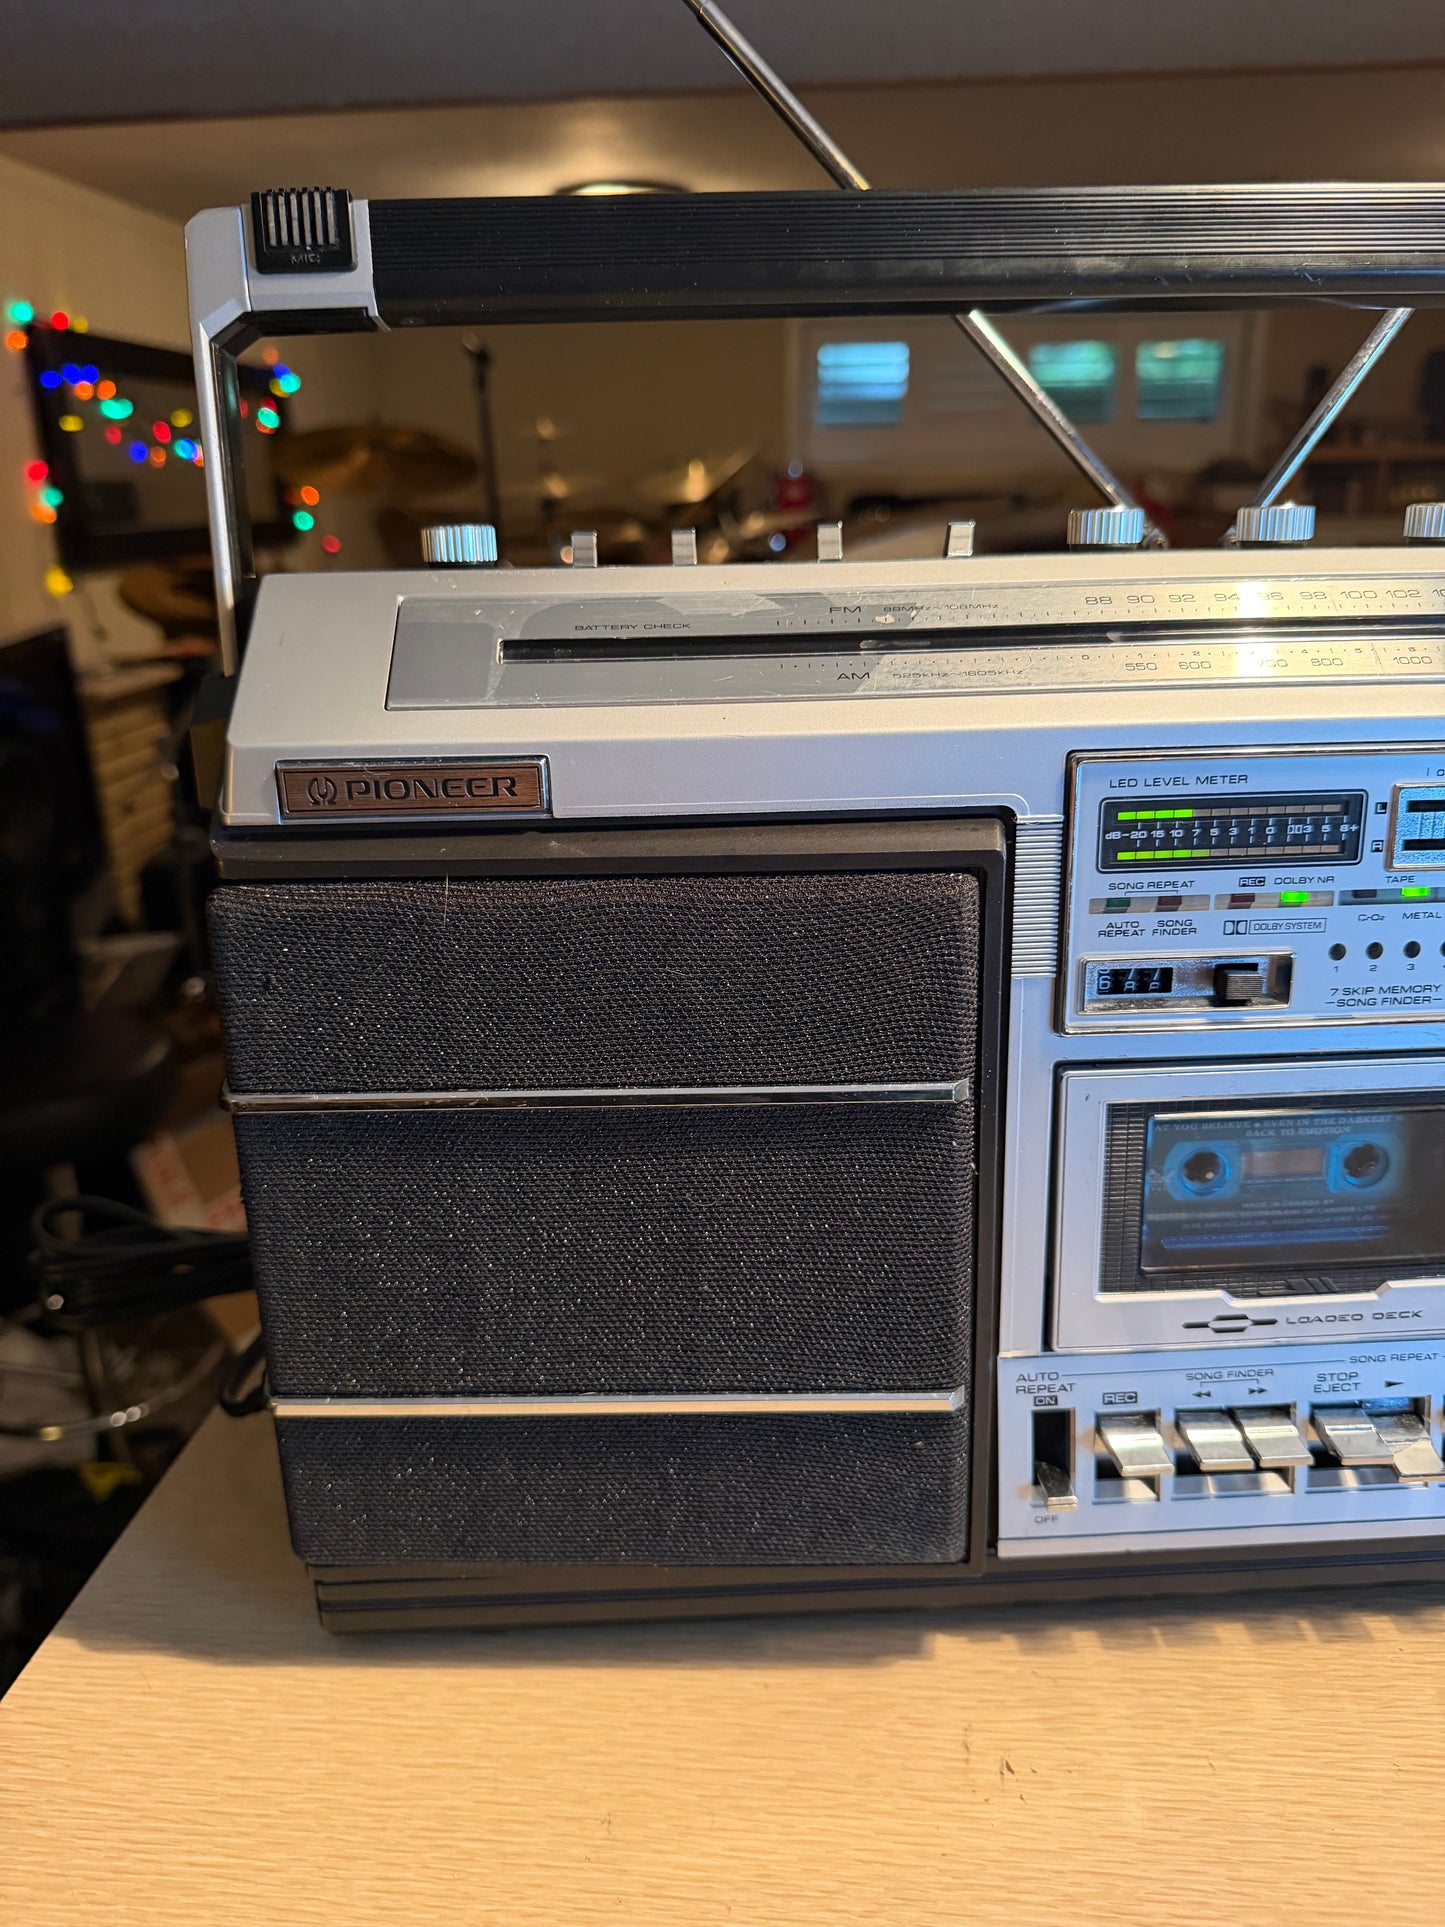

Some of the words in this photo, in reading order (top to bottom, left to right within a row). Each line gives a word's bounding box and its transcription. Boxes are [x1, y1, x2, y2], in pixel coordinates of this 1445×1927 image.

[1085, 596, 1112, 605] 88
[1127, 595, 1155, 604] 90
[1169, 594, 1197, 602] 92
[1214, 593, 1240, 601] 94
[1299, 591, 1327, 600] 98
[1340, 590, 1378, 600] 100
[1385, 589, 1422, 599] 102
[1125, 662, 1157, 671] 550
[1179, 661, 1212, 670] 600
[1310, 658, 1344, 666] 800
[1392, 656, 1432, 665] 1000
[837, 672, 870, 680] AM
[1109, 778, 1138, 788] LED
[1144, 776, 1189, 787] LEVEL
[1195, 774, 1249, 785] METER
[344, 776, 519, 801] PIONEER
[1150, 829, 1165, 838] 15
[1170, 829, 1184, 838] 10
[1192, 828, 1201, 837] 7
[1210, 828, 1219, 836] 5
[1229, 827, 1238, 835] 3
[1248, 827, 1254, 835] 1
[1265, 827, 1274, 835] 0
[1321, 824, 1330, 833] 5
[1240, 877, 1265, 887] REC
[1274, 876, 1314, 885] DOLBY
[1317, 875, 1335, 884] NR
[1385, 875, 1416, 884] TAPE
[1108, 881, 1144, 891] SONG
[1147, 880, 1196, 890] REPEAT
[1402, 911, 1443, 920] METAL
[1105, 920, 1140, 929] AUTO
[1157, 919, 1193, 927] SONG
[1253, 921, 1284, 931] DOLBY
[1285, 921, 1322, 930] SYSTEM
[1098, 929, 1146, 938] REPEAT
[1152, 927, 1197, 936] FINDER
[1369, 964, 1378, 972] 2
[1406, 963, 1415, 971] 3
[1330, 988, 1339, 997] 7
[1342, 987, 1375, 996] SKIP
[1379, 984, 1443, 995] MEMORY
[1336, 998, 1378, 1007] SONG
[1381, 996, 1432, 1006] FINDER
[1174, 1122, 1198, 1131] YOU
[1246, 1128, 1275, 1137] BACK
[1280, 1127, 1295, 1136] TO
[1298, 1126, 1351, 1136] EMOTION
[1286, 1312, 1363, 1324] LOADED
[1371, 1310, 1422, 1321] DECK
[1349, 1354, 1386, 1363] SONG
[1391, 1352, 1438, 1362] REPEAT
[1016, 1371, 1059, 1382] AUTO
[1185, 1371, 1223, 1381] SONG
[1227, 1368, 1274, 1379] FINDER
[1316, 1371, 1359, 1382] STOP
[1015, 1383, 1076, 1394] REPEAT
[1313, 1382, 1361, 1393] EJECT
[1034, 1396, 1056, 1405] ON
[1103, 1392, 1137, 1404] REC
[1034, 1514, 1059, 1524] OFF
